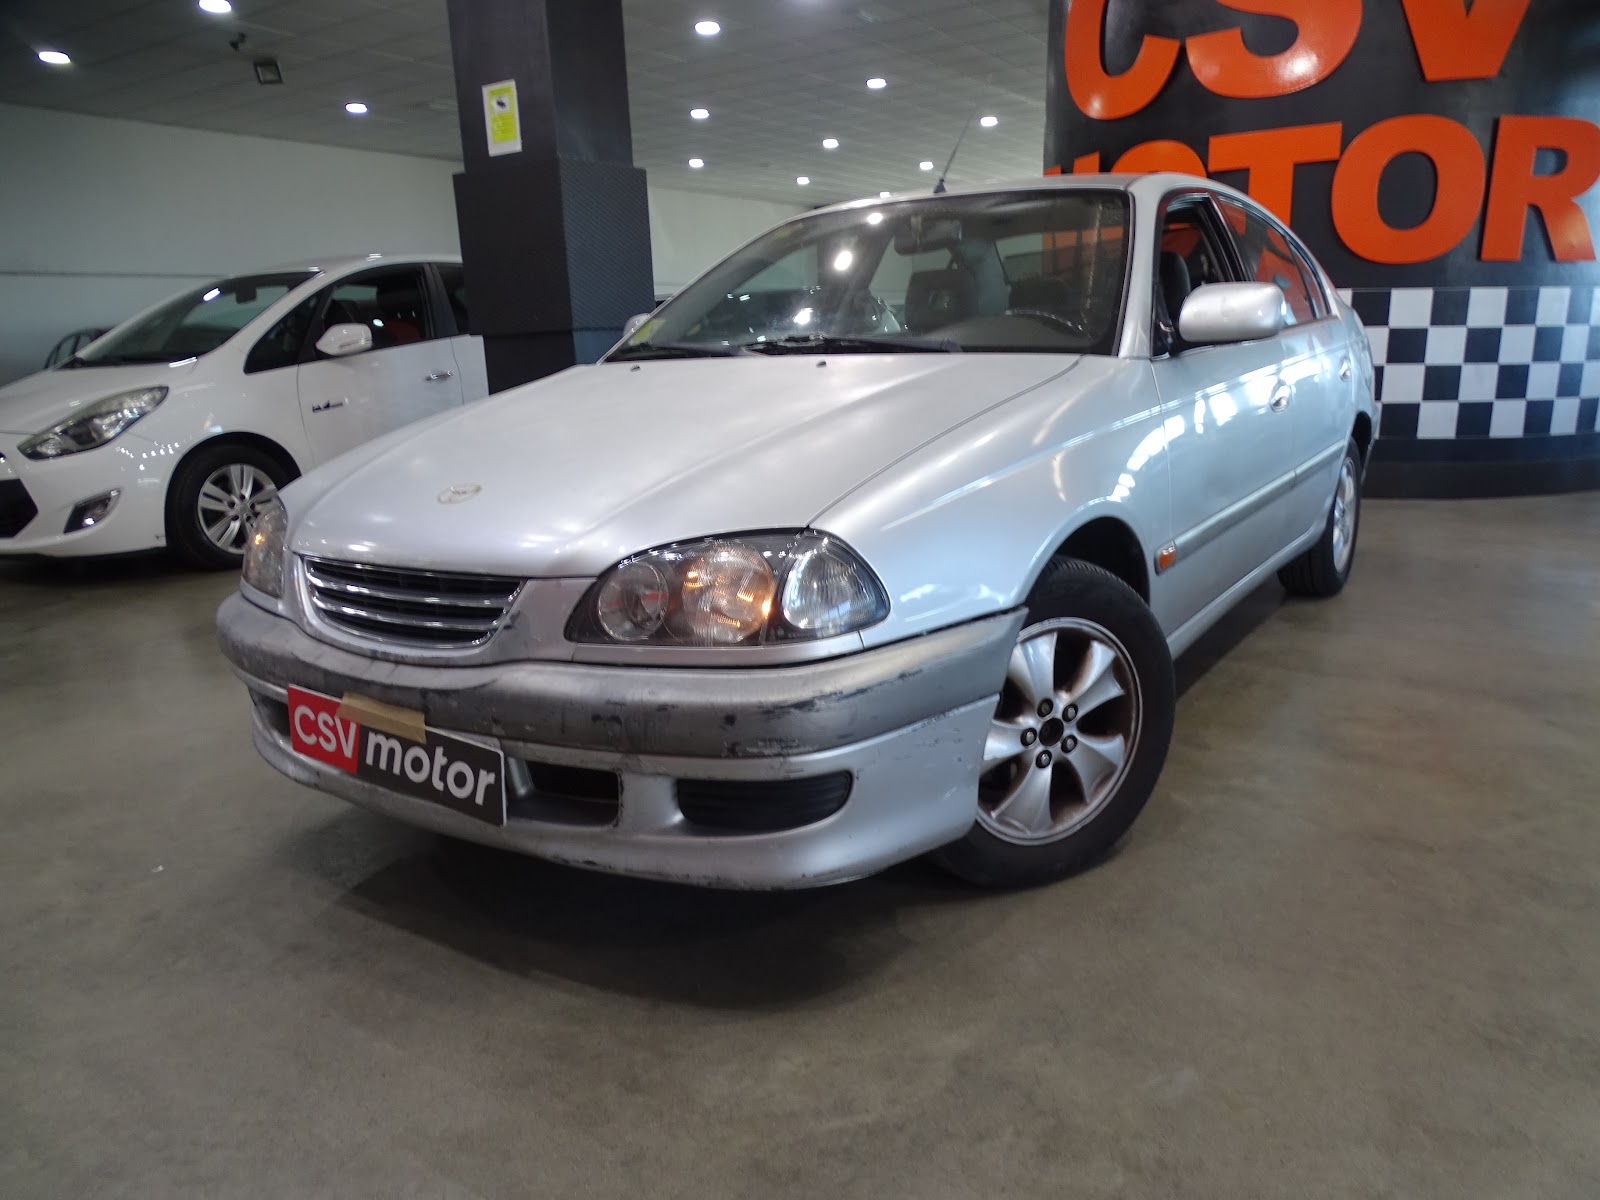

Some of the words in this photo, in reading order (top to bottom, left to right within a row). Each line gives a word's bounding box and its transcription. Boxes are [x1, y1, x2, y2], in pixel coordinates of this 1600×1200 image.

[1043, 114, 1600, 265] TOR
[294, 704, 357, 759] CSV
[366, 730, 496, 806] motor
